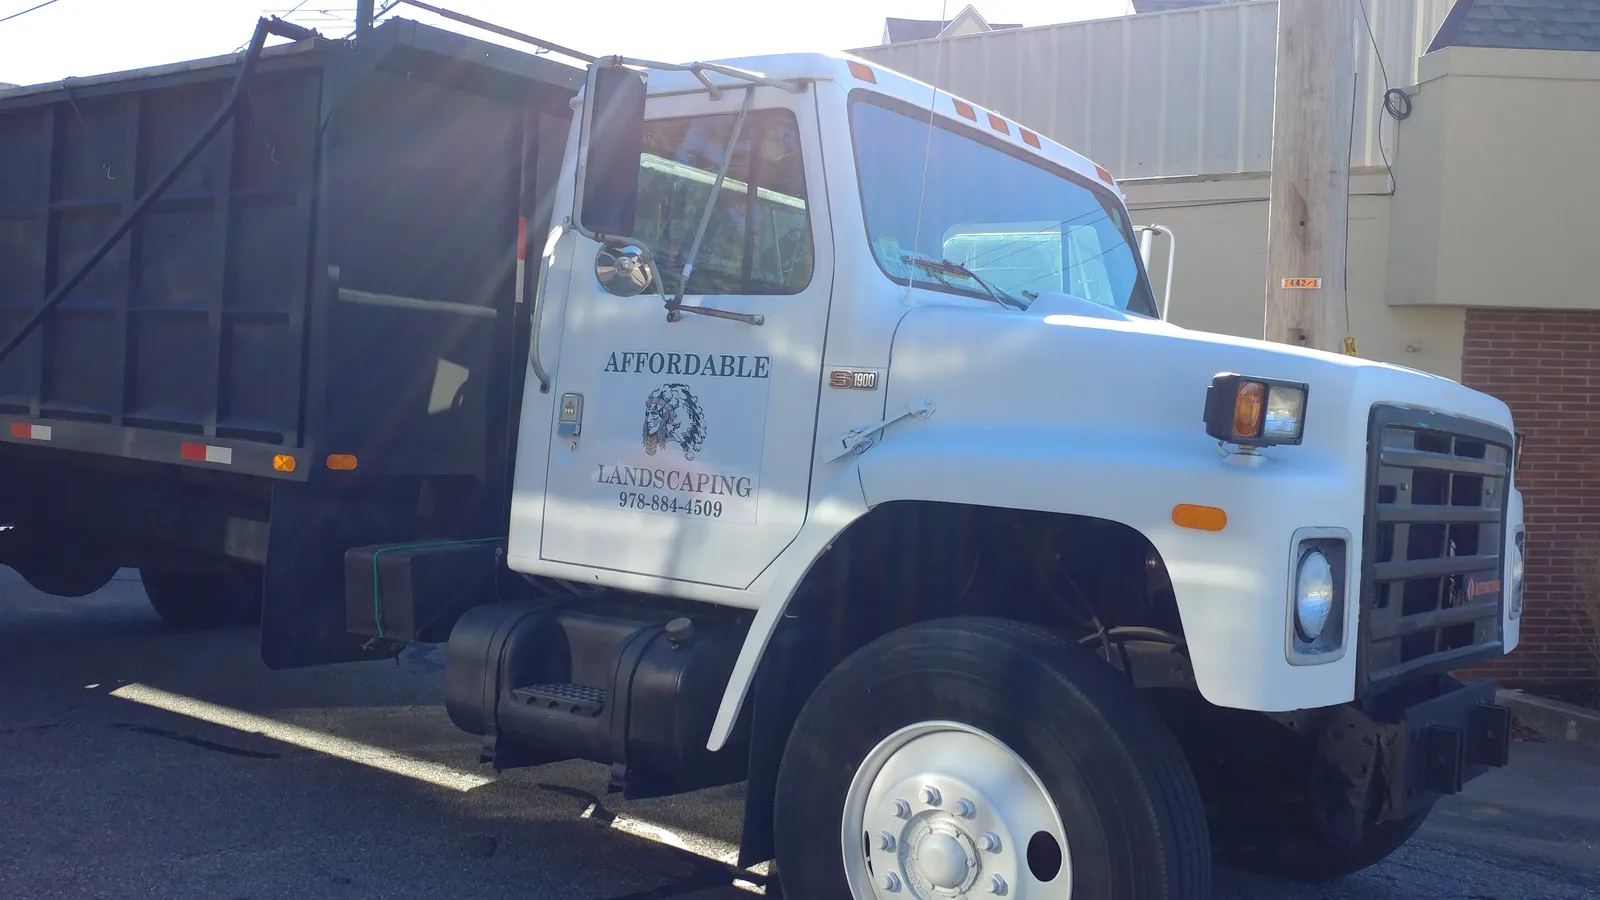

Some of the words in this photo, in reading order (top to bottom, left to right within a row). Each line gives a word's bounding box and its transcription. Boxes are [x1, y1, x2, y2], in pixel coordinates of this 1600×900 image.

[604, 351, 770, 379] AFFORDABLE
[853, 372, 875, 388] 1900
[597, 464, 752, 498] LANDSCAPING
[619, 491, 723, 518] 978-884-4509
